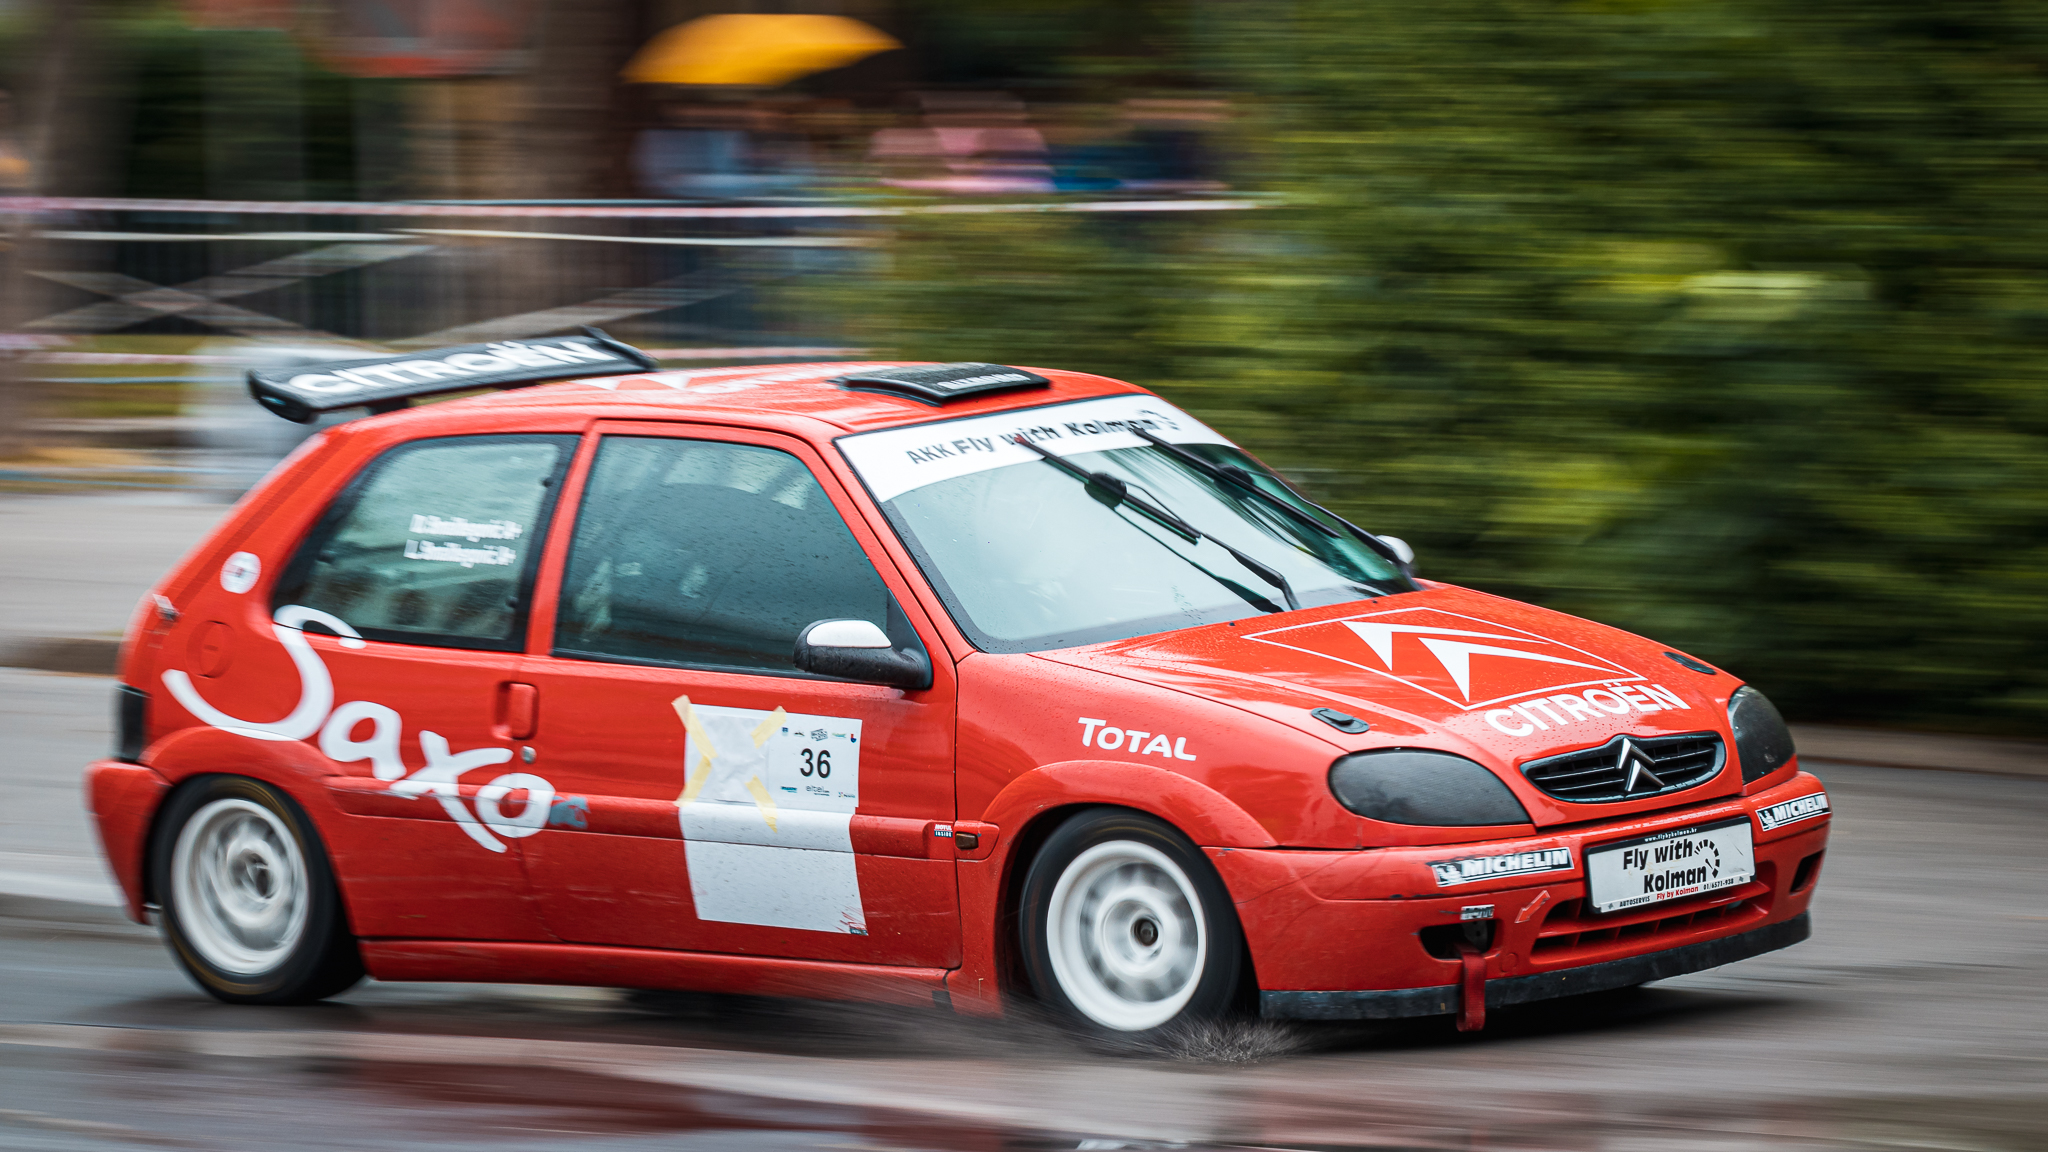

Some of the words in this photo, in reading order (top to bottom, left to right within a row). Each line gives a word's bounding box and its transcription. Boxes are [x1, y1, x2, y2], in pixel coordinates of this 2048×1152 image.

[289, 340, 617, 392] CITROËN
[906, 443, 955, 464] AKK
[952, 437, 995, 453] Fly
[1000, 426, 1062, 445] with
[1484, 681, 1691, 737] CITROËN
[161, 604, 556, 853] Saxo
[1078, 716, 1197, 761] TOTAL
[800, 747, 831, 778] 36
[1772, 794, 1829, 821] MICHELIN
[1460, 849, 1569, 877] MICHELIN
[1623, 848, 1649, 870] Fly
[1655, 838, 1693, 864] with
[1643, 865, 1707, 894] Kolman
[1619, 895, 1651, 908] AUTOSERVIS
[1656, 892, 1666, 901] Fly
[1666, 890, 1674, 899] by
[1675, 886, 1699, 897] Kolman
